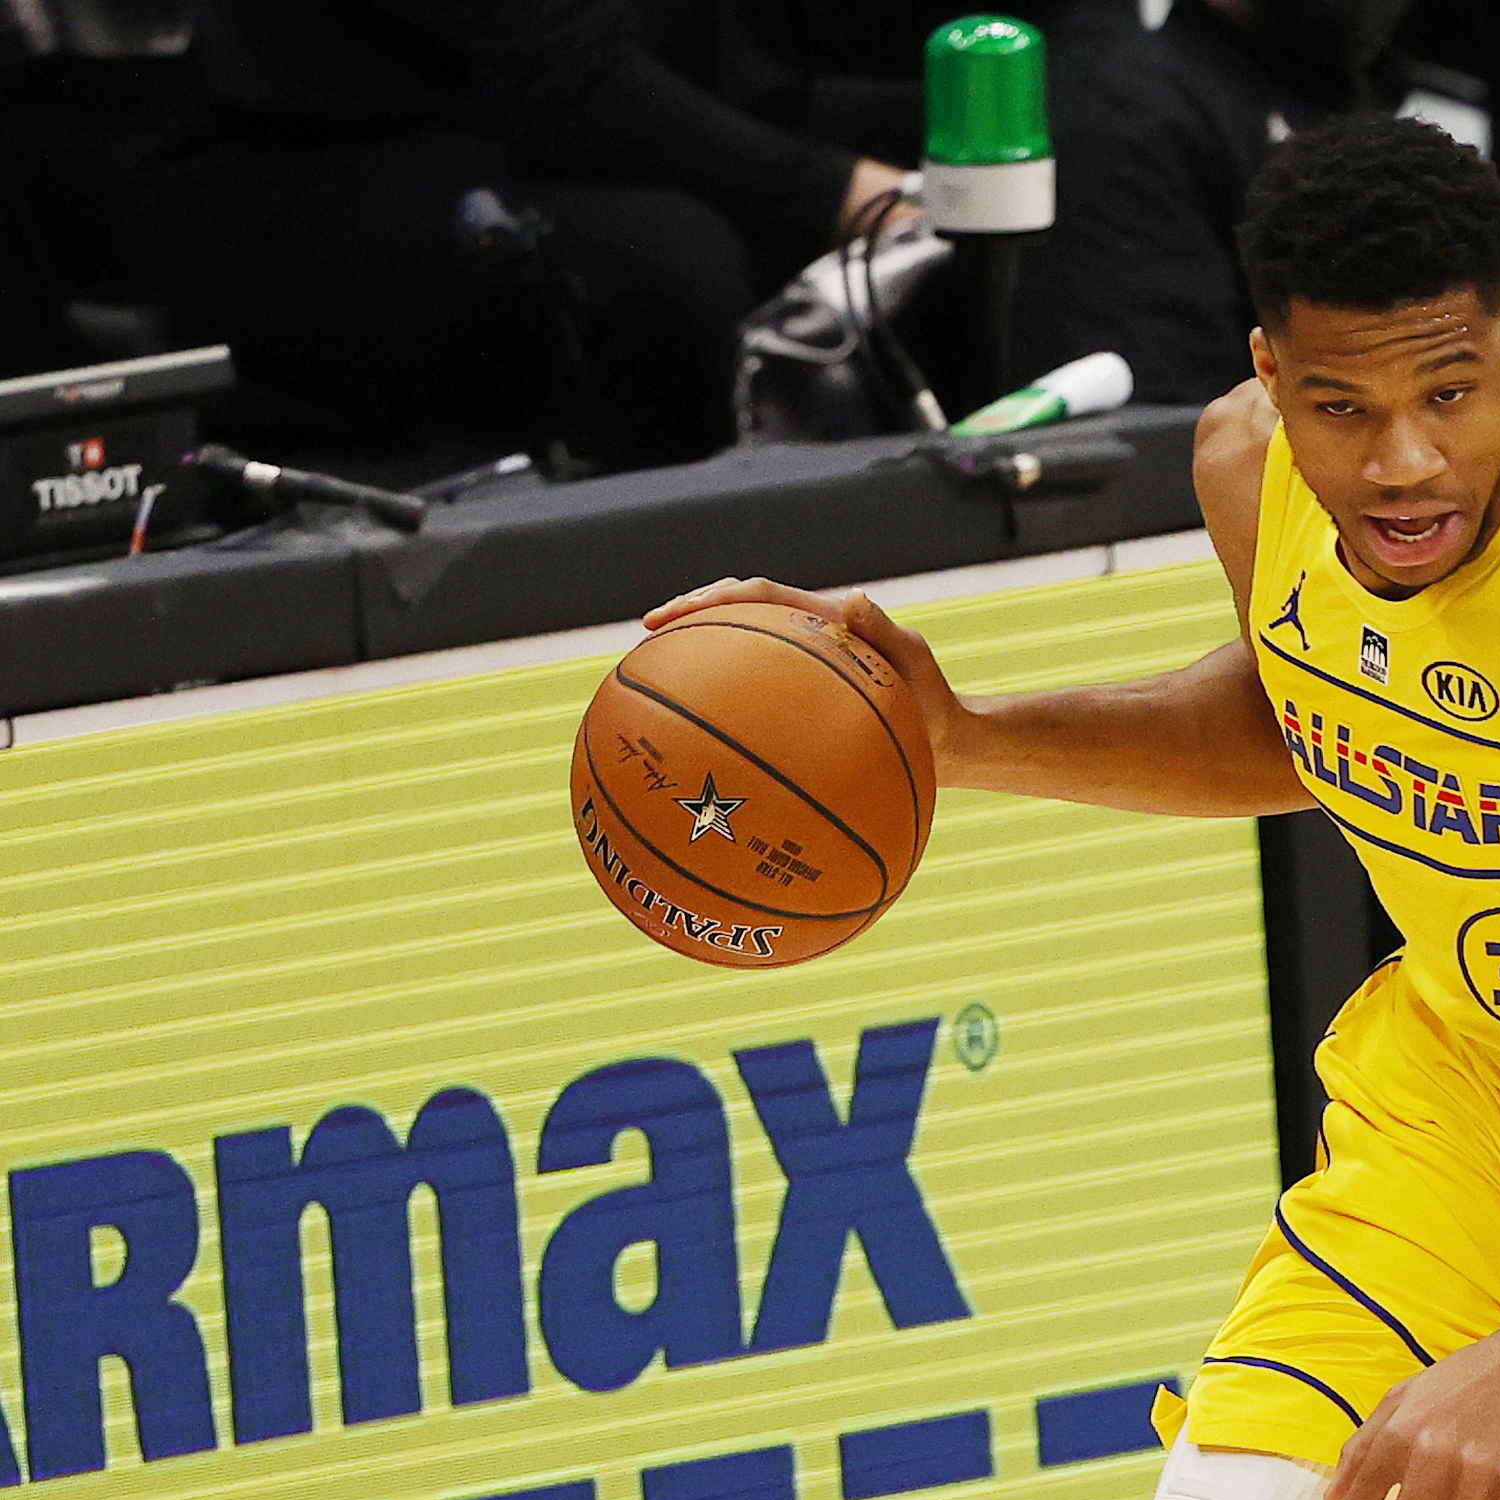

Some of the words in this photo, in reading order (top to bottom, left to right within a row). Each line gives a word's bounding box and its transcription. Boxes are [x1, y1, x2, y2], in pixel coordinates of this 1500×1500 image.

[31, 463, 144, 512] TISSOT
[1434, 668, 1488, 714] KIA
[577, 796, 784, 959] SPALDING
[0, 1015, 975, 1487] Rmax
